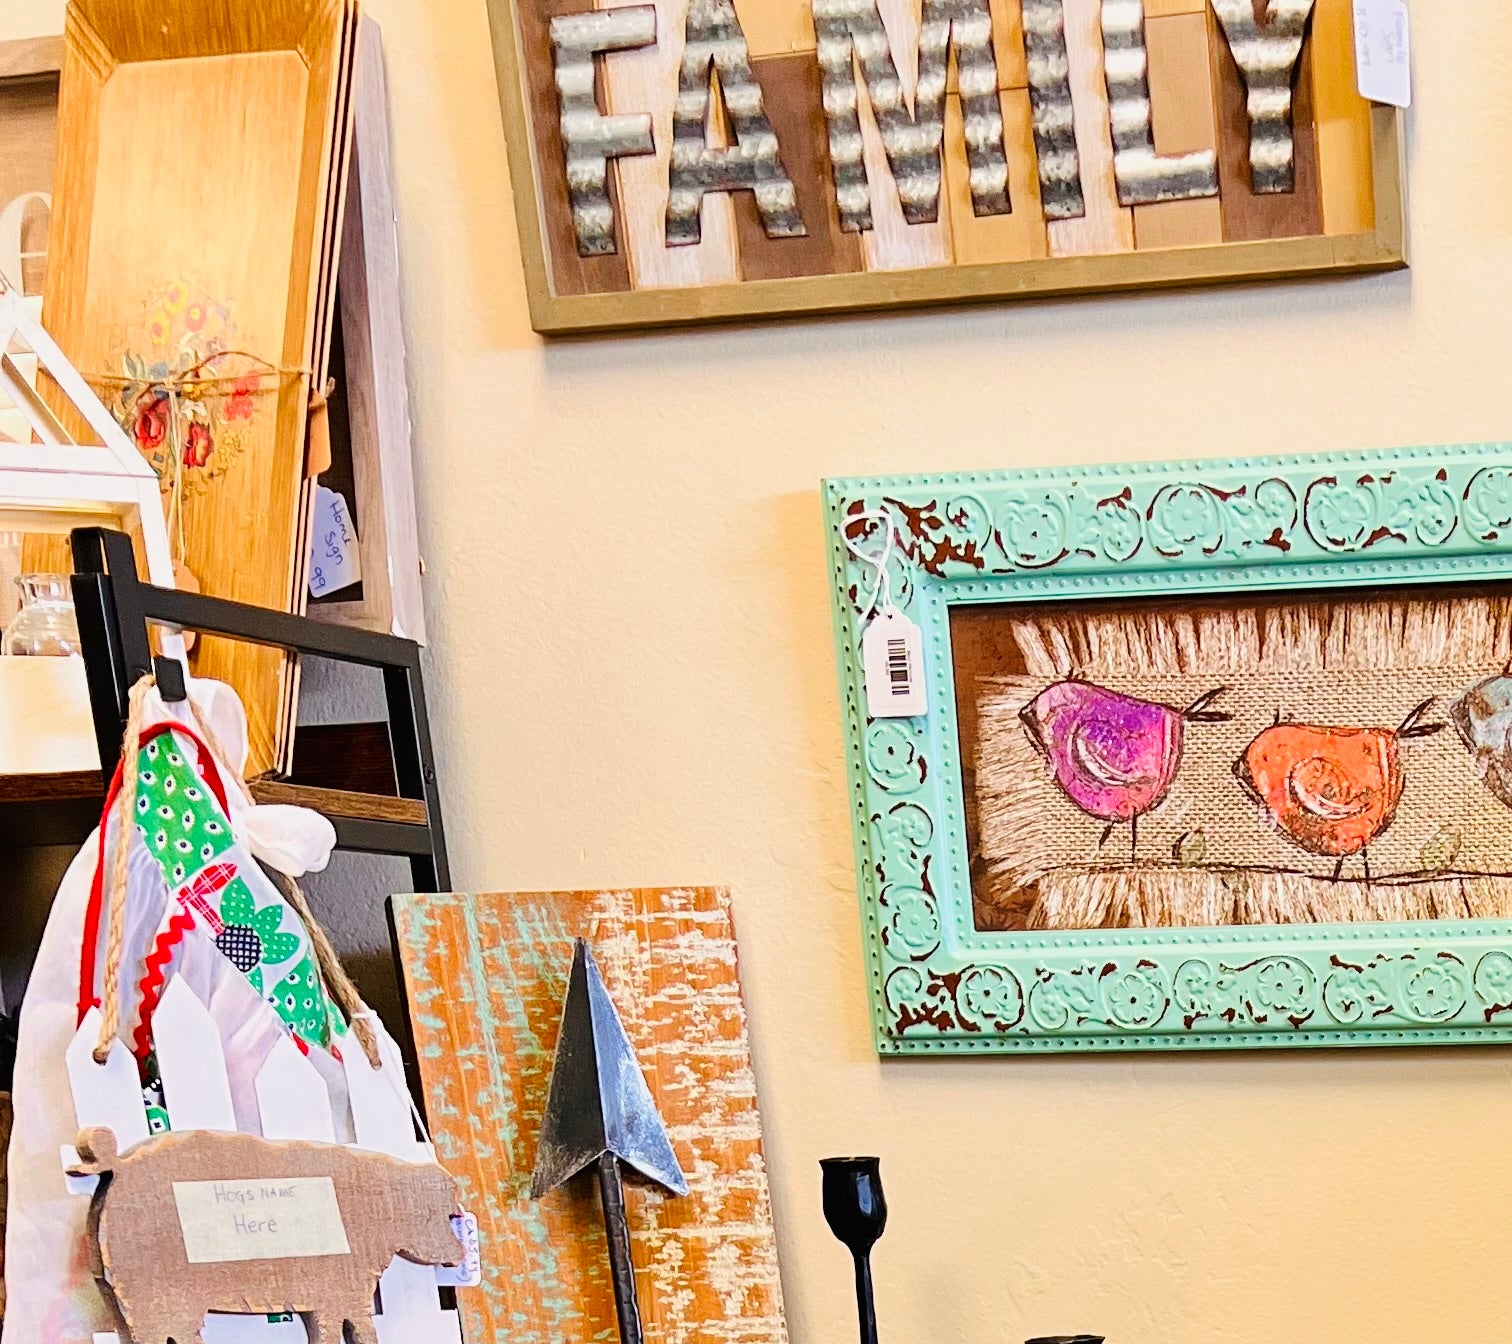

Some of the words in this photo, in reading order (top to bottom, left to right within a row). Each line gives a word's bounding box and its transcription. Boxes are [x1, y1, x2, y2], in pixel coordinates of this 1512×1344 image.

[549, 0, 1314, 257] FAMILY
[329, 500, 352, 547] Home
[324, 531, 344, 565] Sign
[233, 1213, 278, 1235] Here
